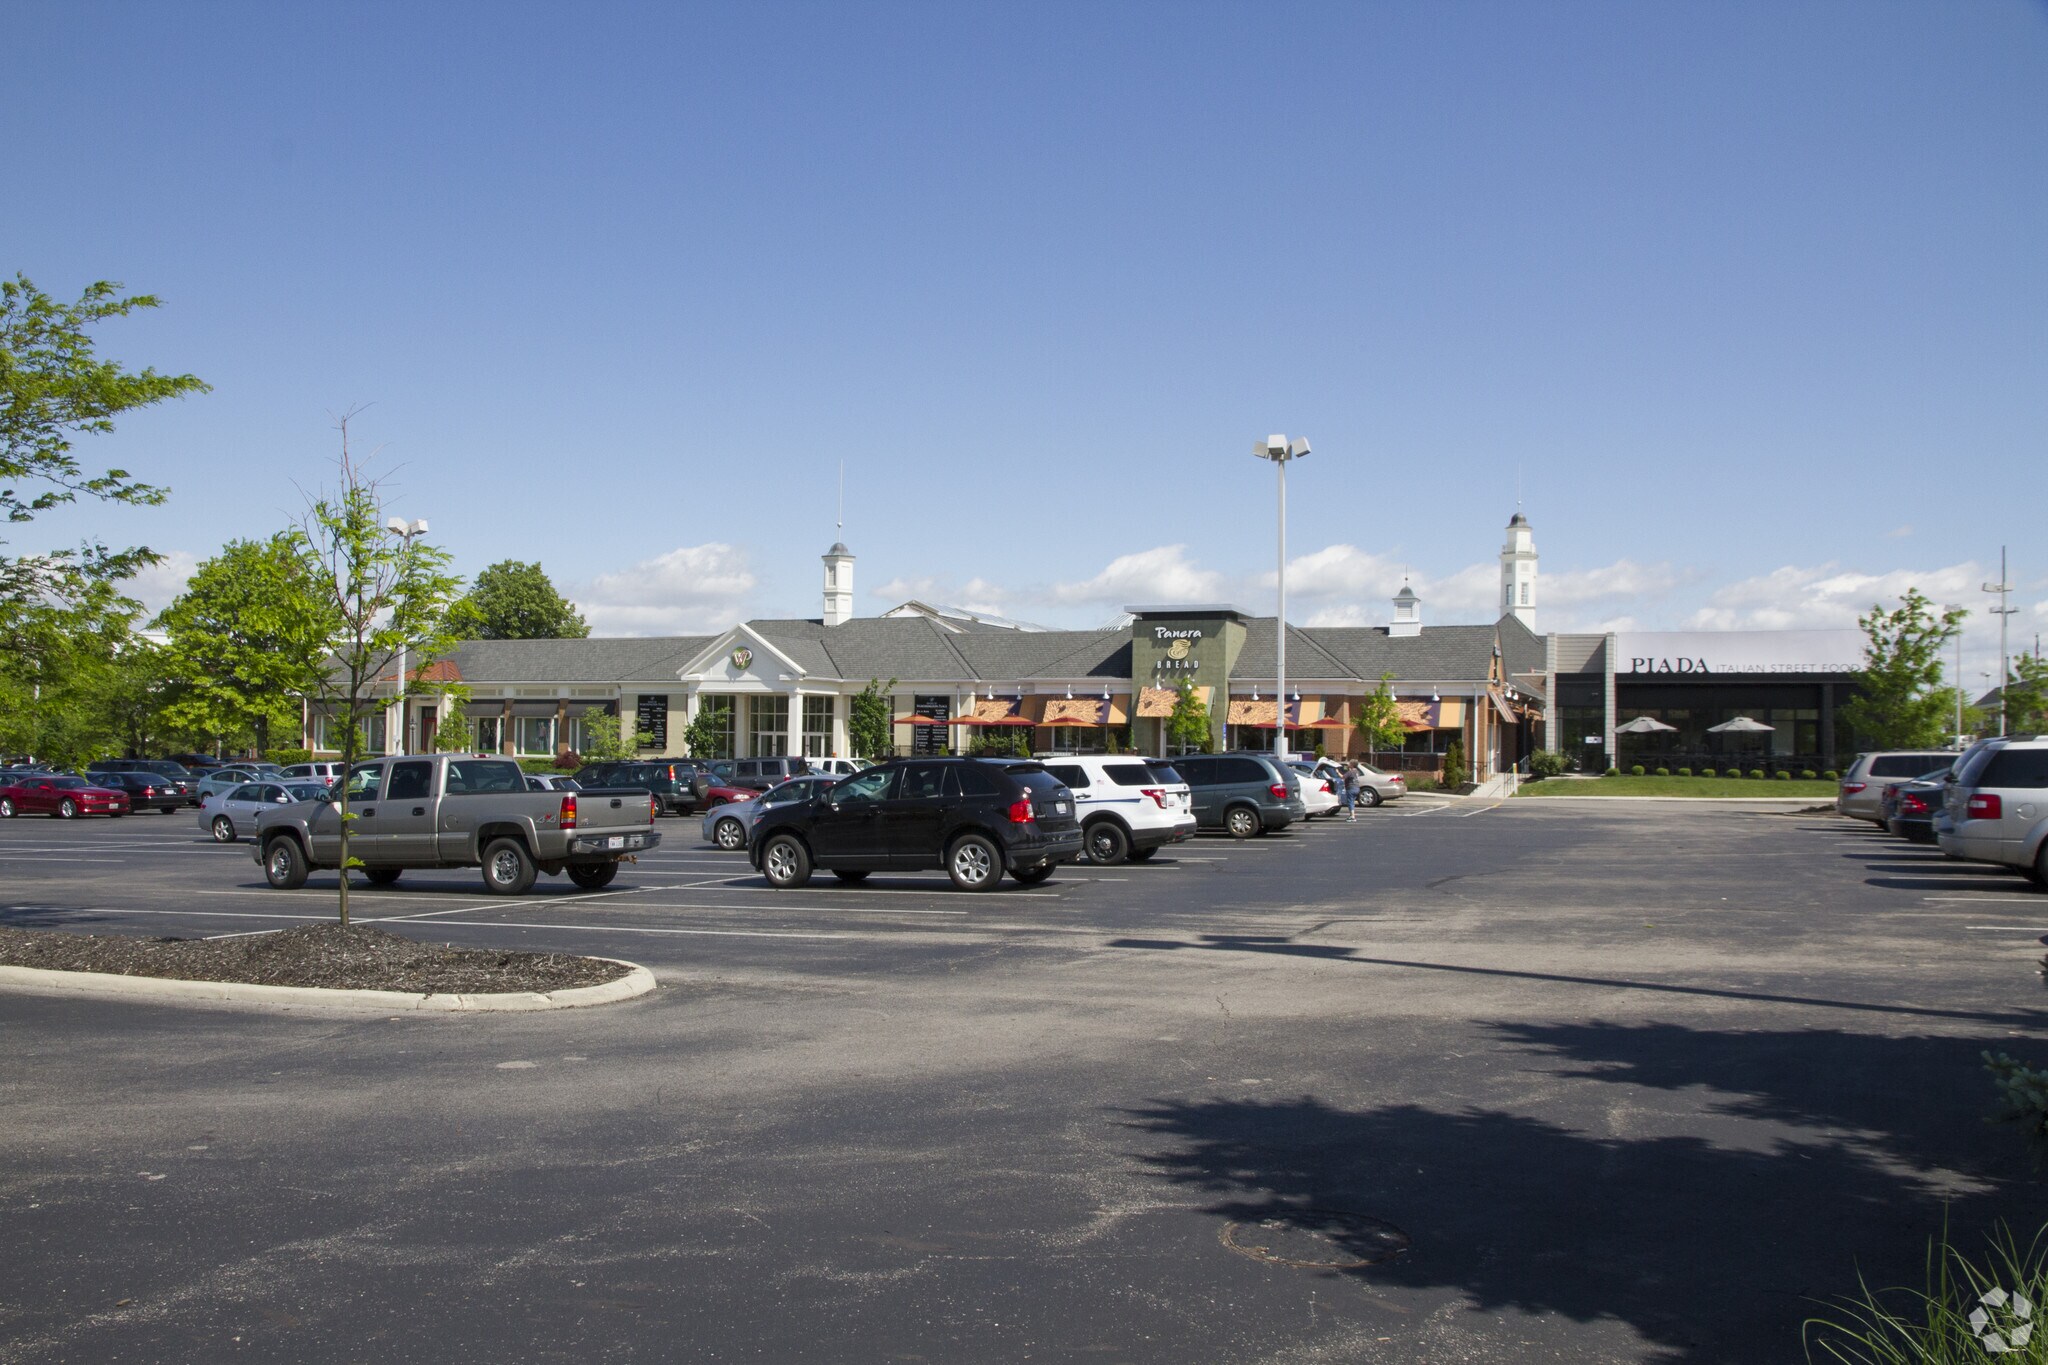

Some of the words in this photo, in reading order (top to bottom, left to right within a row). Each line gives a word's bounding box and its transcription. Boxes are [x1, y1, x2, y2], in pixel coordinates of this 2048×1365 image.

[1154, 626, 1202, 638] Panera
[1157, 660, 1199, 668] BREAD
[1631, 657, 1710, 673] PIADA
[1716, 664, 1765, 673] ITALIAN
[1770, 664, 1816, 673] STREET
[1822, 663, 1861, 673] FOOD
